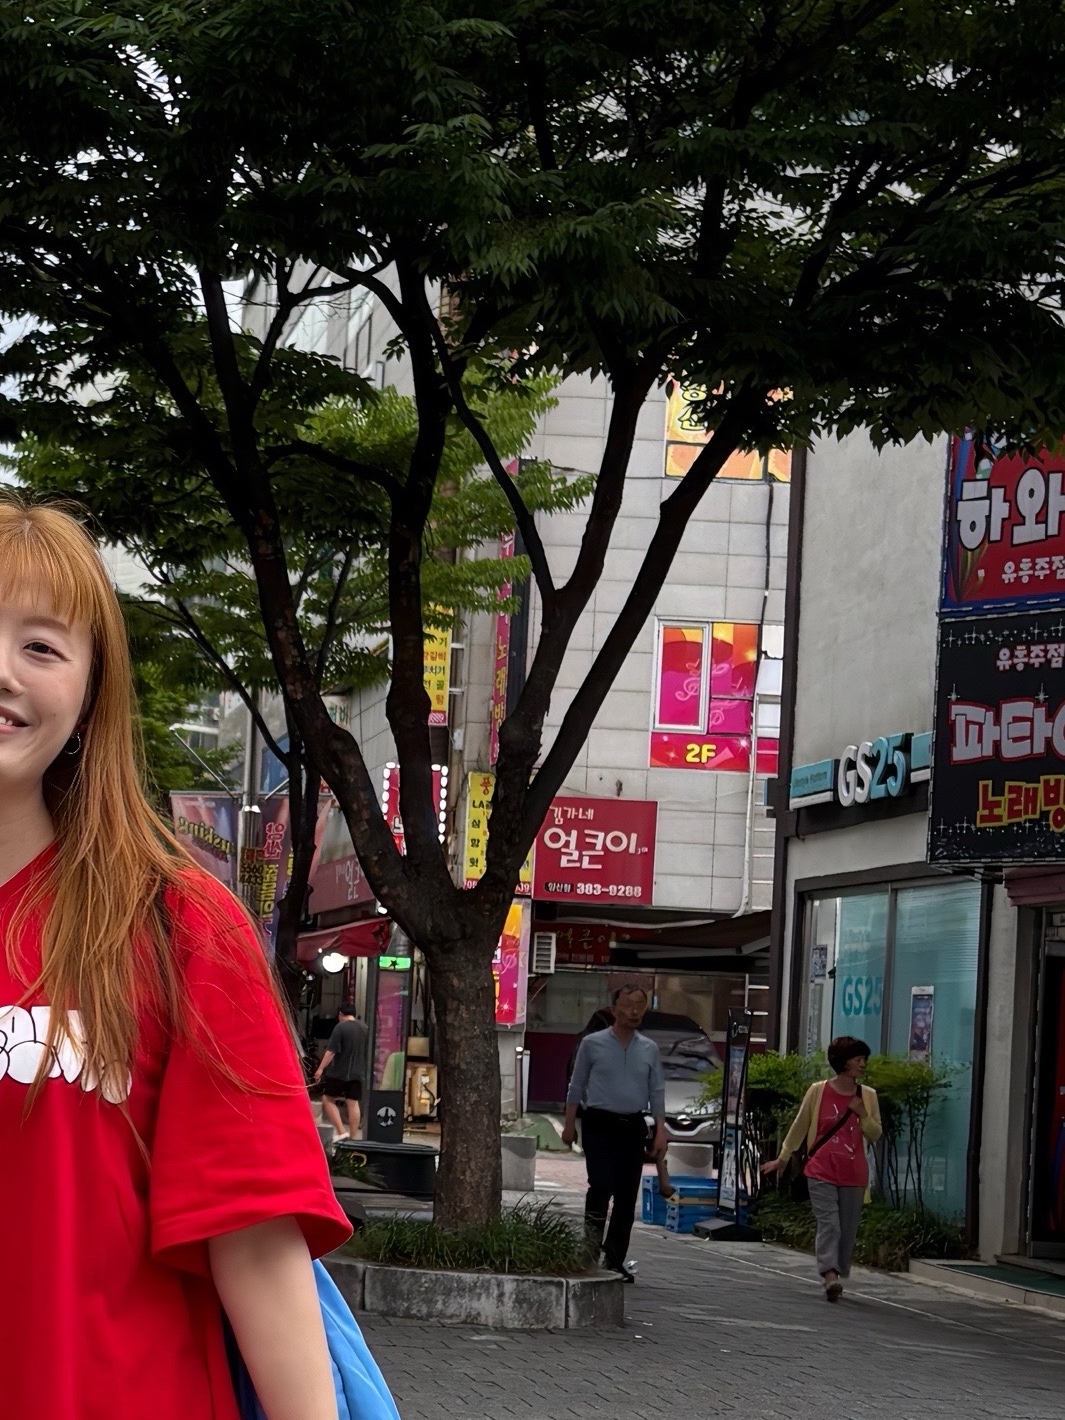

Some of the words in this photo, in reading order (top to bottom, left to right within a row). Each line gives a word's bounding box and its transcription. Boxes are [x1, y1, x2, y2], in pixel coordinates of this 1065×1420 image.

[996, 643, 1065, 671] 유흥주점
[685, 744, 717, 764] 2F
[838, 737, 906, 807] GS25
[549, 806, 594, 825] 김가네
[544, 827, 638, 869] 얼큰이
[842, 974, 882, 1017] GS25
